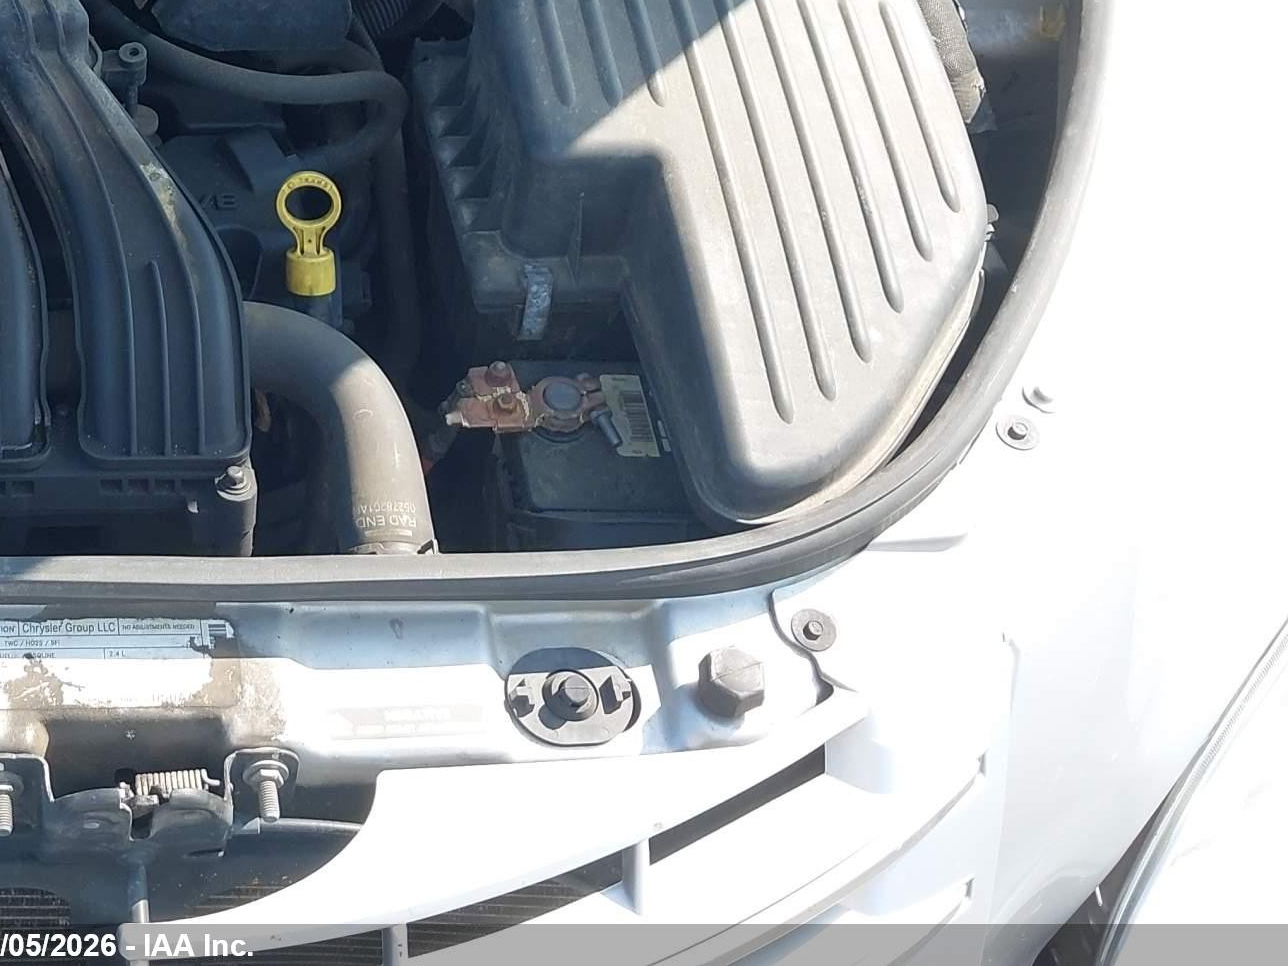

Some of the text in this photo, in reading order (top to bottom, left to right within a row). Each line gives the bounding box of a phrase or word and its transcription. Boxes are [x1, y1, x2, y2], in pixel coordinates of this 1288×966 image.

[356, 515, 416, 528] RAD END
[22, 620, 116, 636] Chrysler Group LLC
